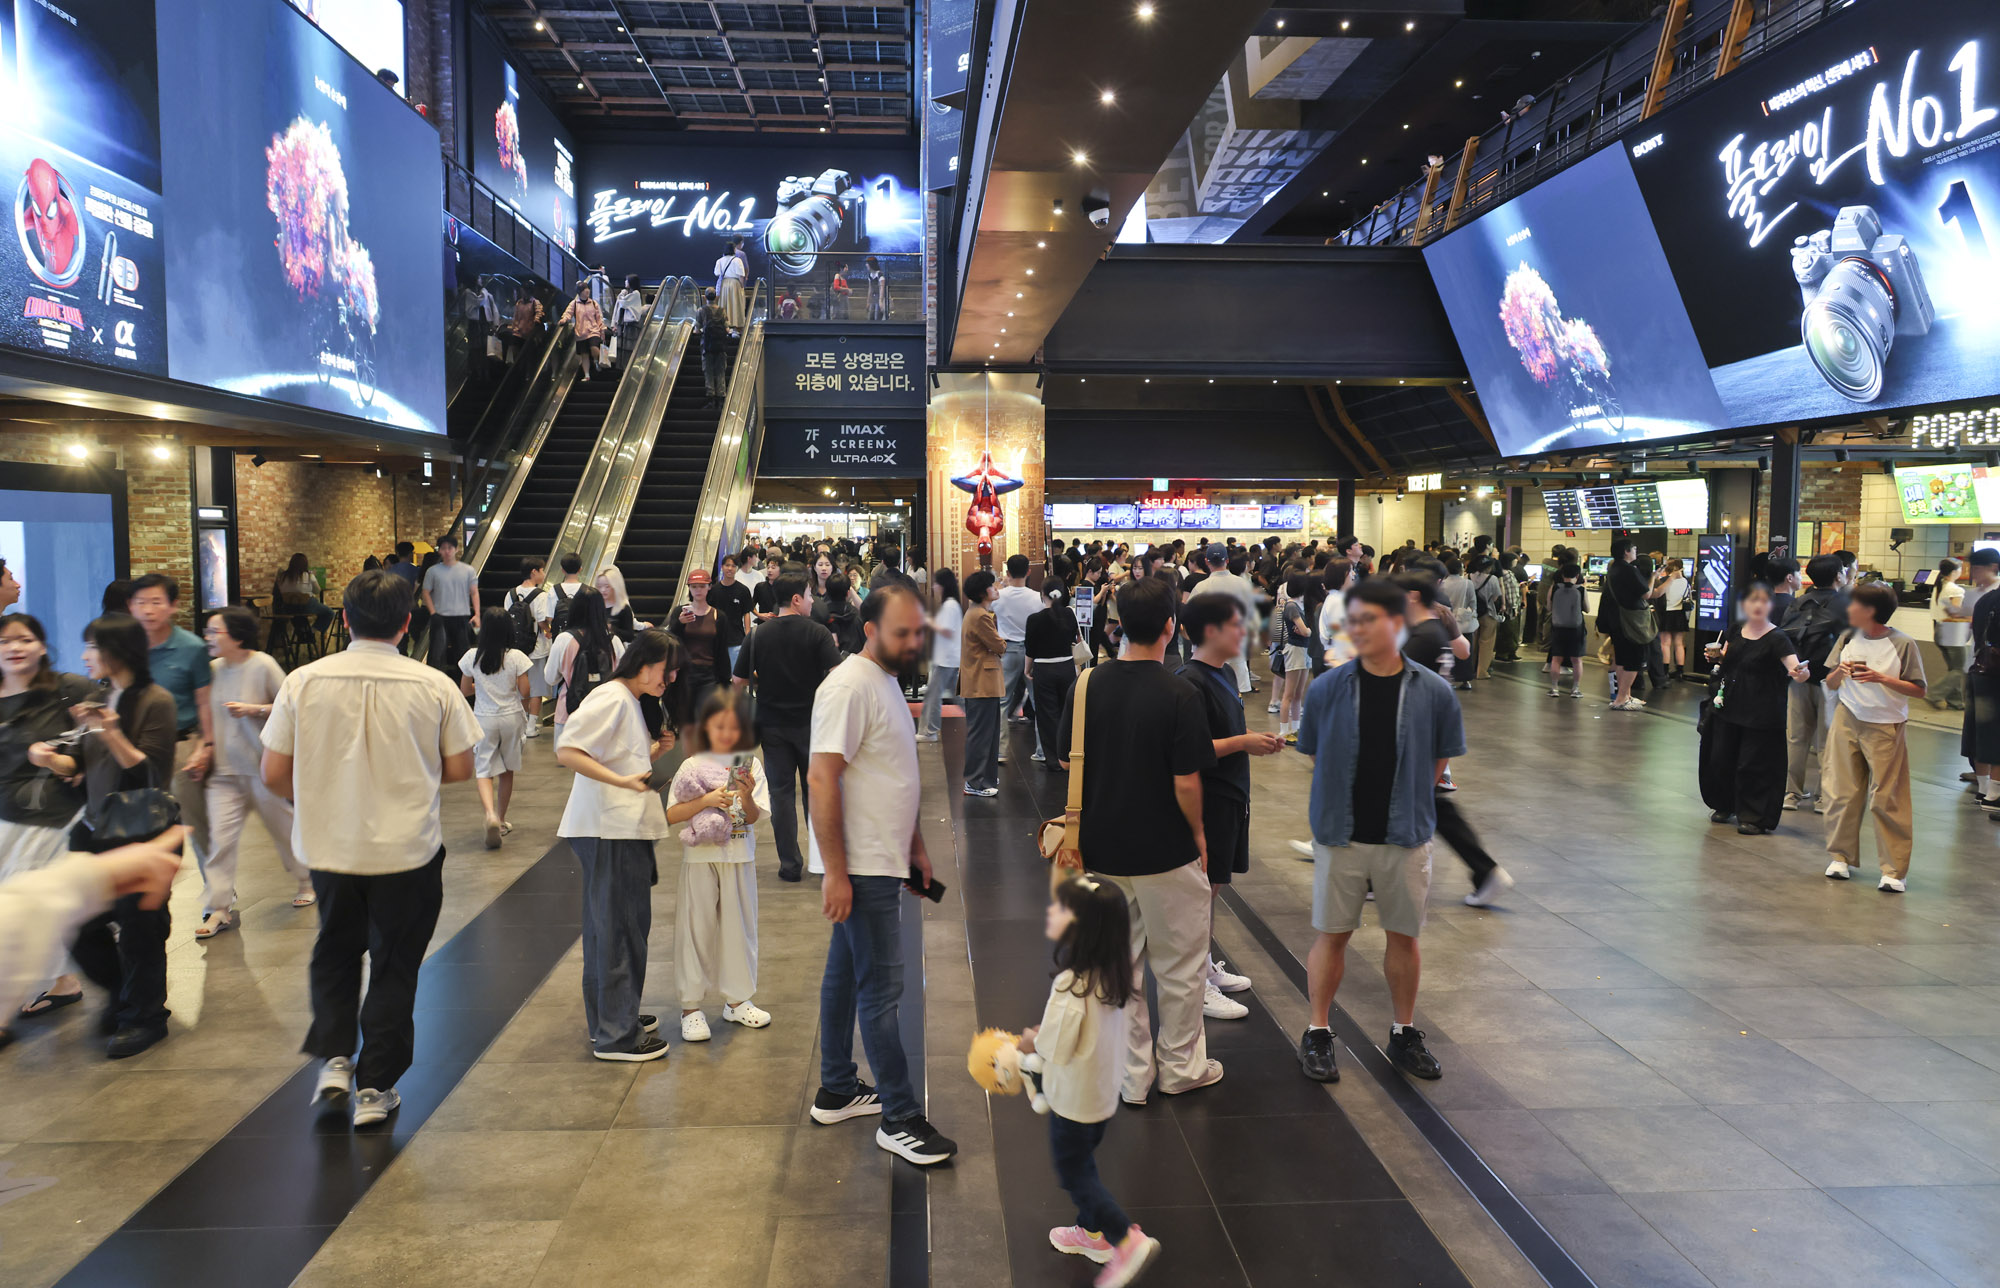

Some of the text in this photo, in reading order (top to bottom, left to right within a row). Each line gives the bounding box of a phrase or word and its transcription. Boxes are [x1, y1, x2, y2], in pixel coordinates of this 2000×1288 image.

[1633, 133, 1664, 158] SONY
[1719, 41, 1998, 248] 풀프레임 No.1
[586, 189, 755, 243] 풀프레임 No.1
[805, 353, 905, 370] 모든 상영관은
[795, 374, 915, 391] 위층에 있습니다.
[805, 429, 820, 441] 7F
[840, 425, 885, 434] IMAX
[831, 439, 896, 448] SCREENX
[1144, 498, 1208, 509] SELF ORDER
